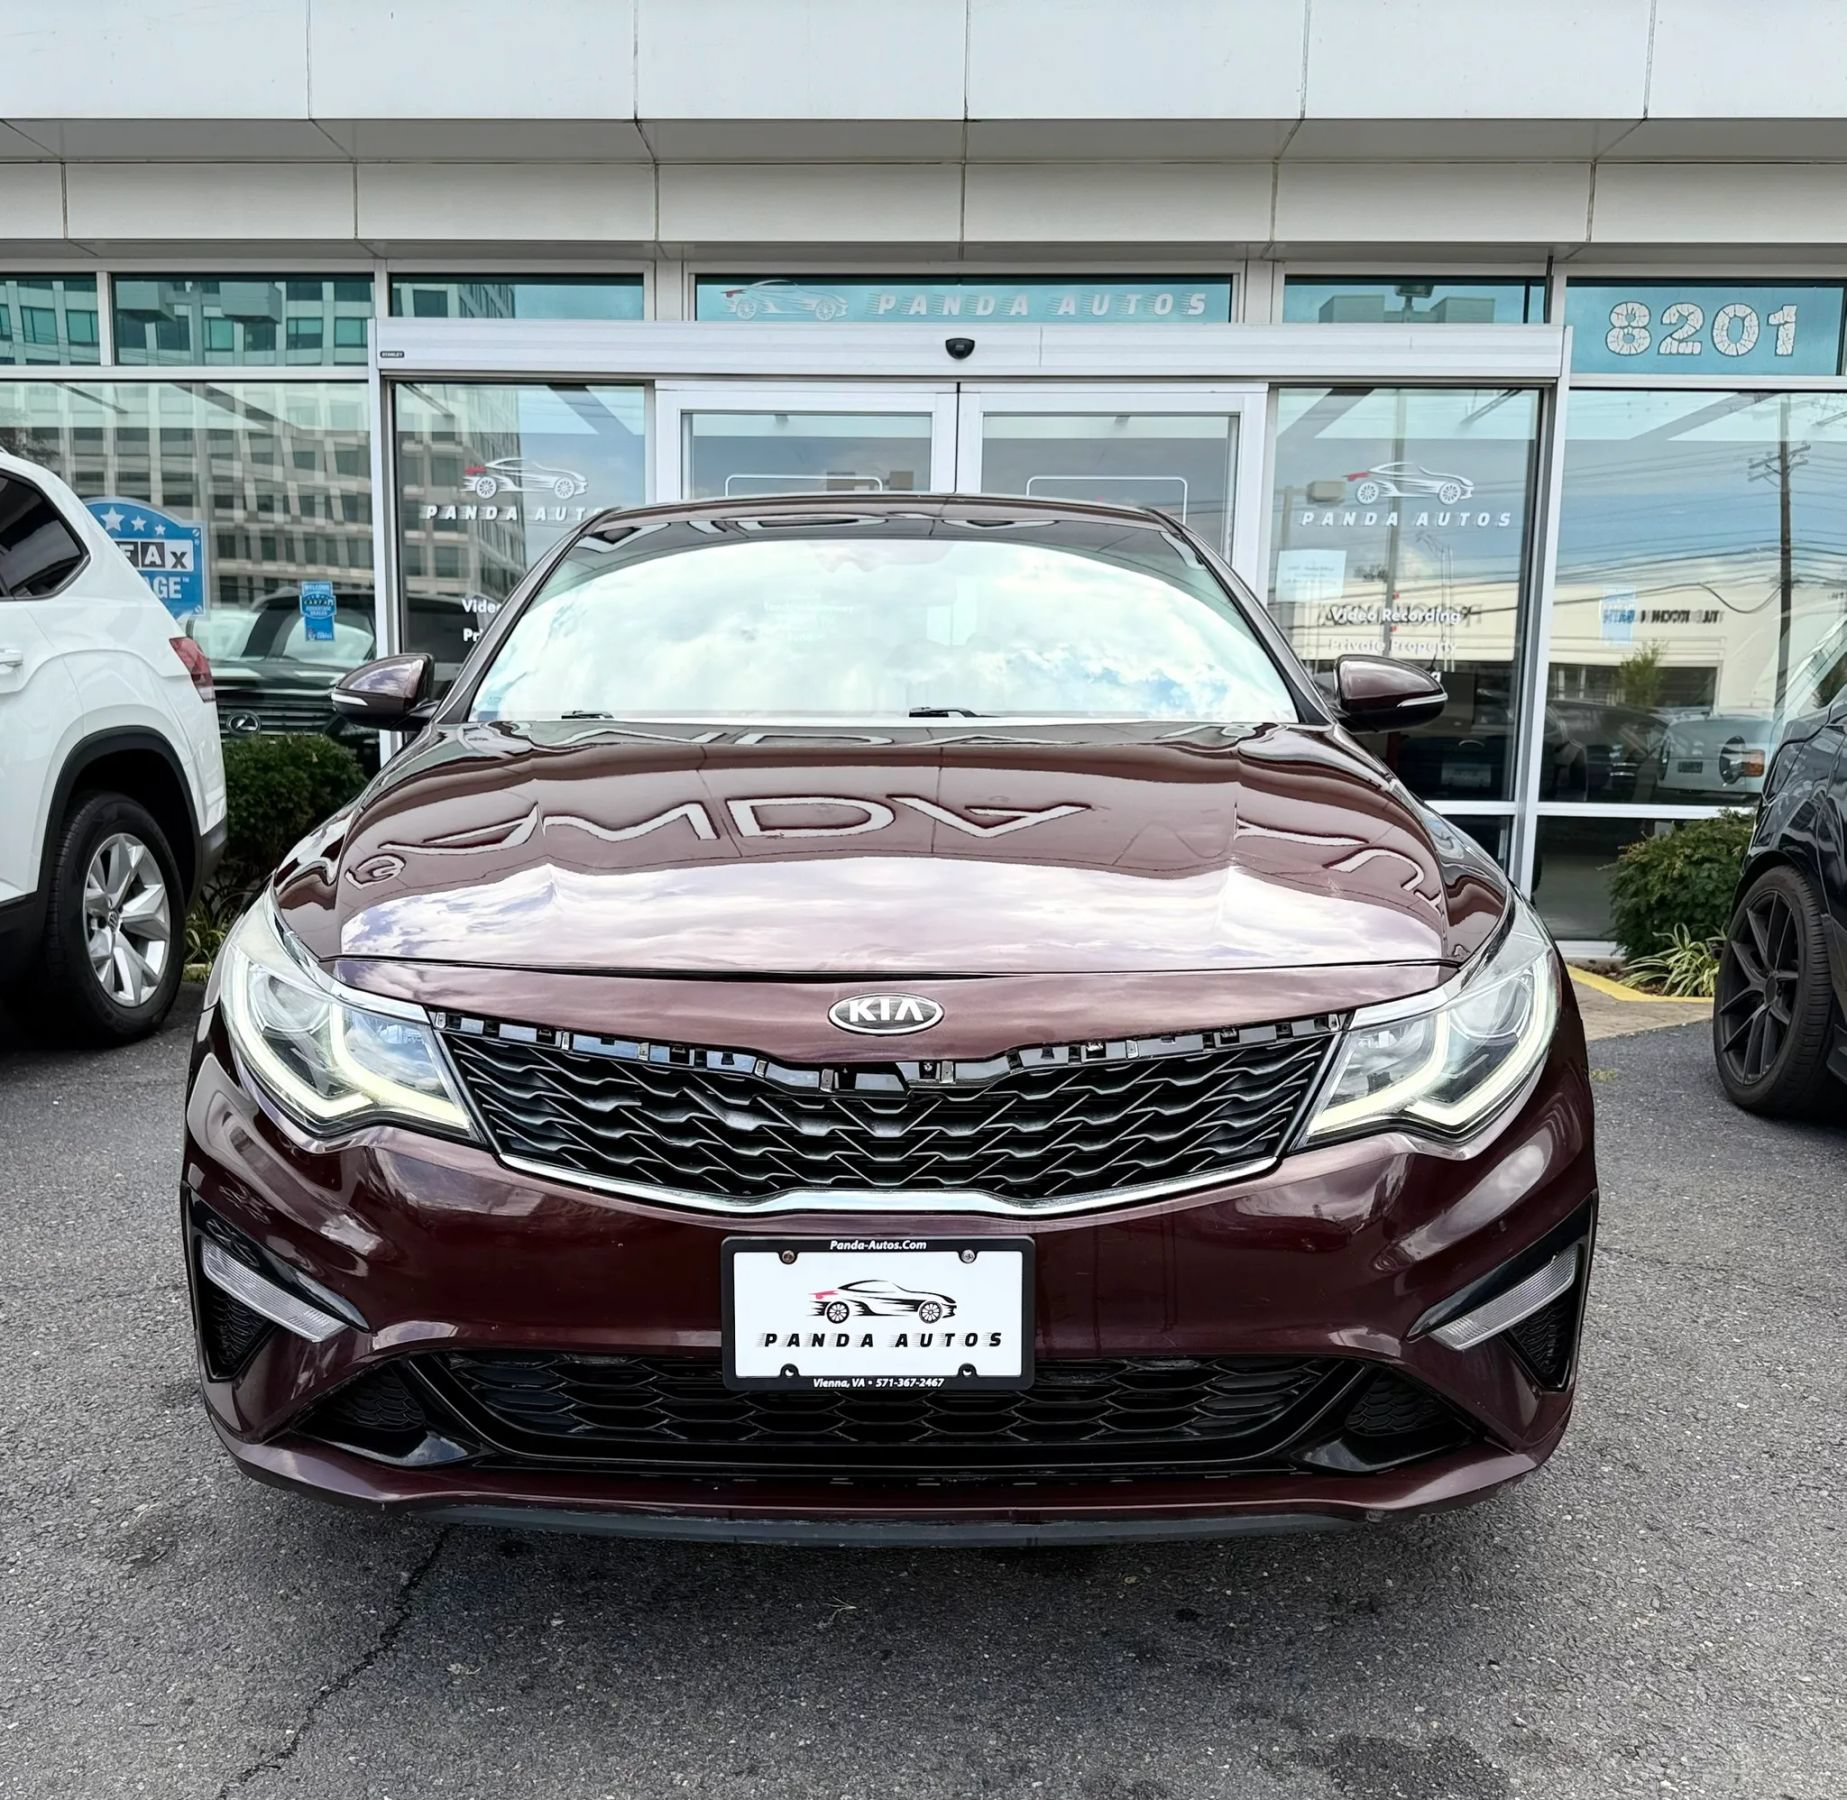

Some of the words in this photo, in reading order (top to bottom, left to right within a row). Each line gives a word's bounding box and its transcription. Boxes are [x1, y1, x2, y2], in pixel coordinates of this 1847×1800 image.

[876, 294, 1029, 317] PANDA
[1055, 292, 1207, 317] AUTOS
[1605, 301, 1798, 357] 8201
[424, 505, 518, 521] PANDA
[1302, 511, 1399, 526] PANDA
[1416, 511, 1511, 527] AUTOS
[1331, 606, 1378, 622] Video
[1381, 606, 1461, 625] Recording
[849, 998, 924, 1022] KIA
[829, 1239, 927, 1250] Panda-Autos.Com
[763, 1332, 874, 1348] PANDA
[894, 1332, 1002, 1348] AUTOS
[813, 1378, 851, 1388] Vienna,
[852, 1378, 865, 1388] VA
[875, 1378, 945, 1388] 571-367-2467
